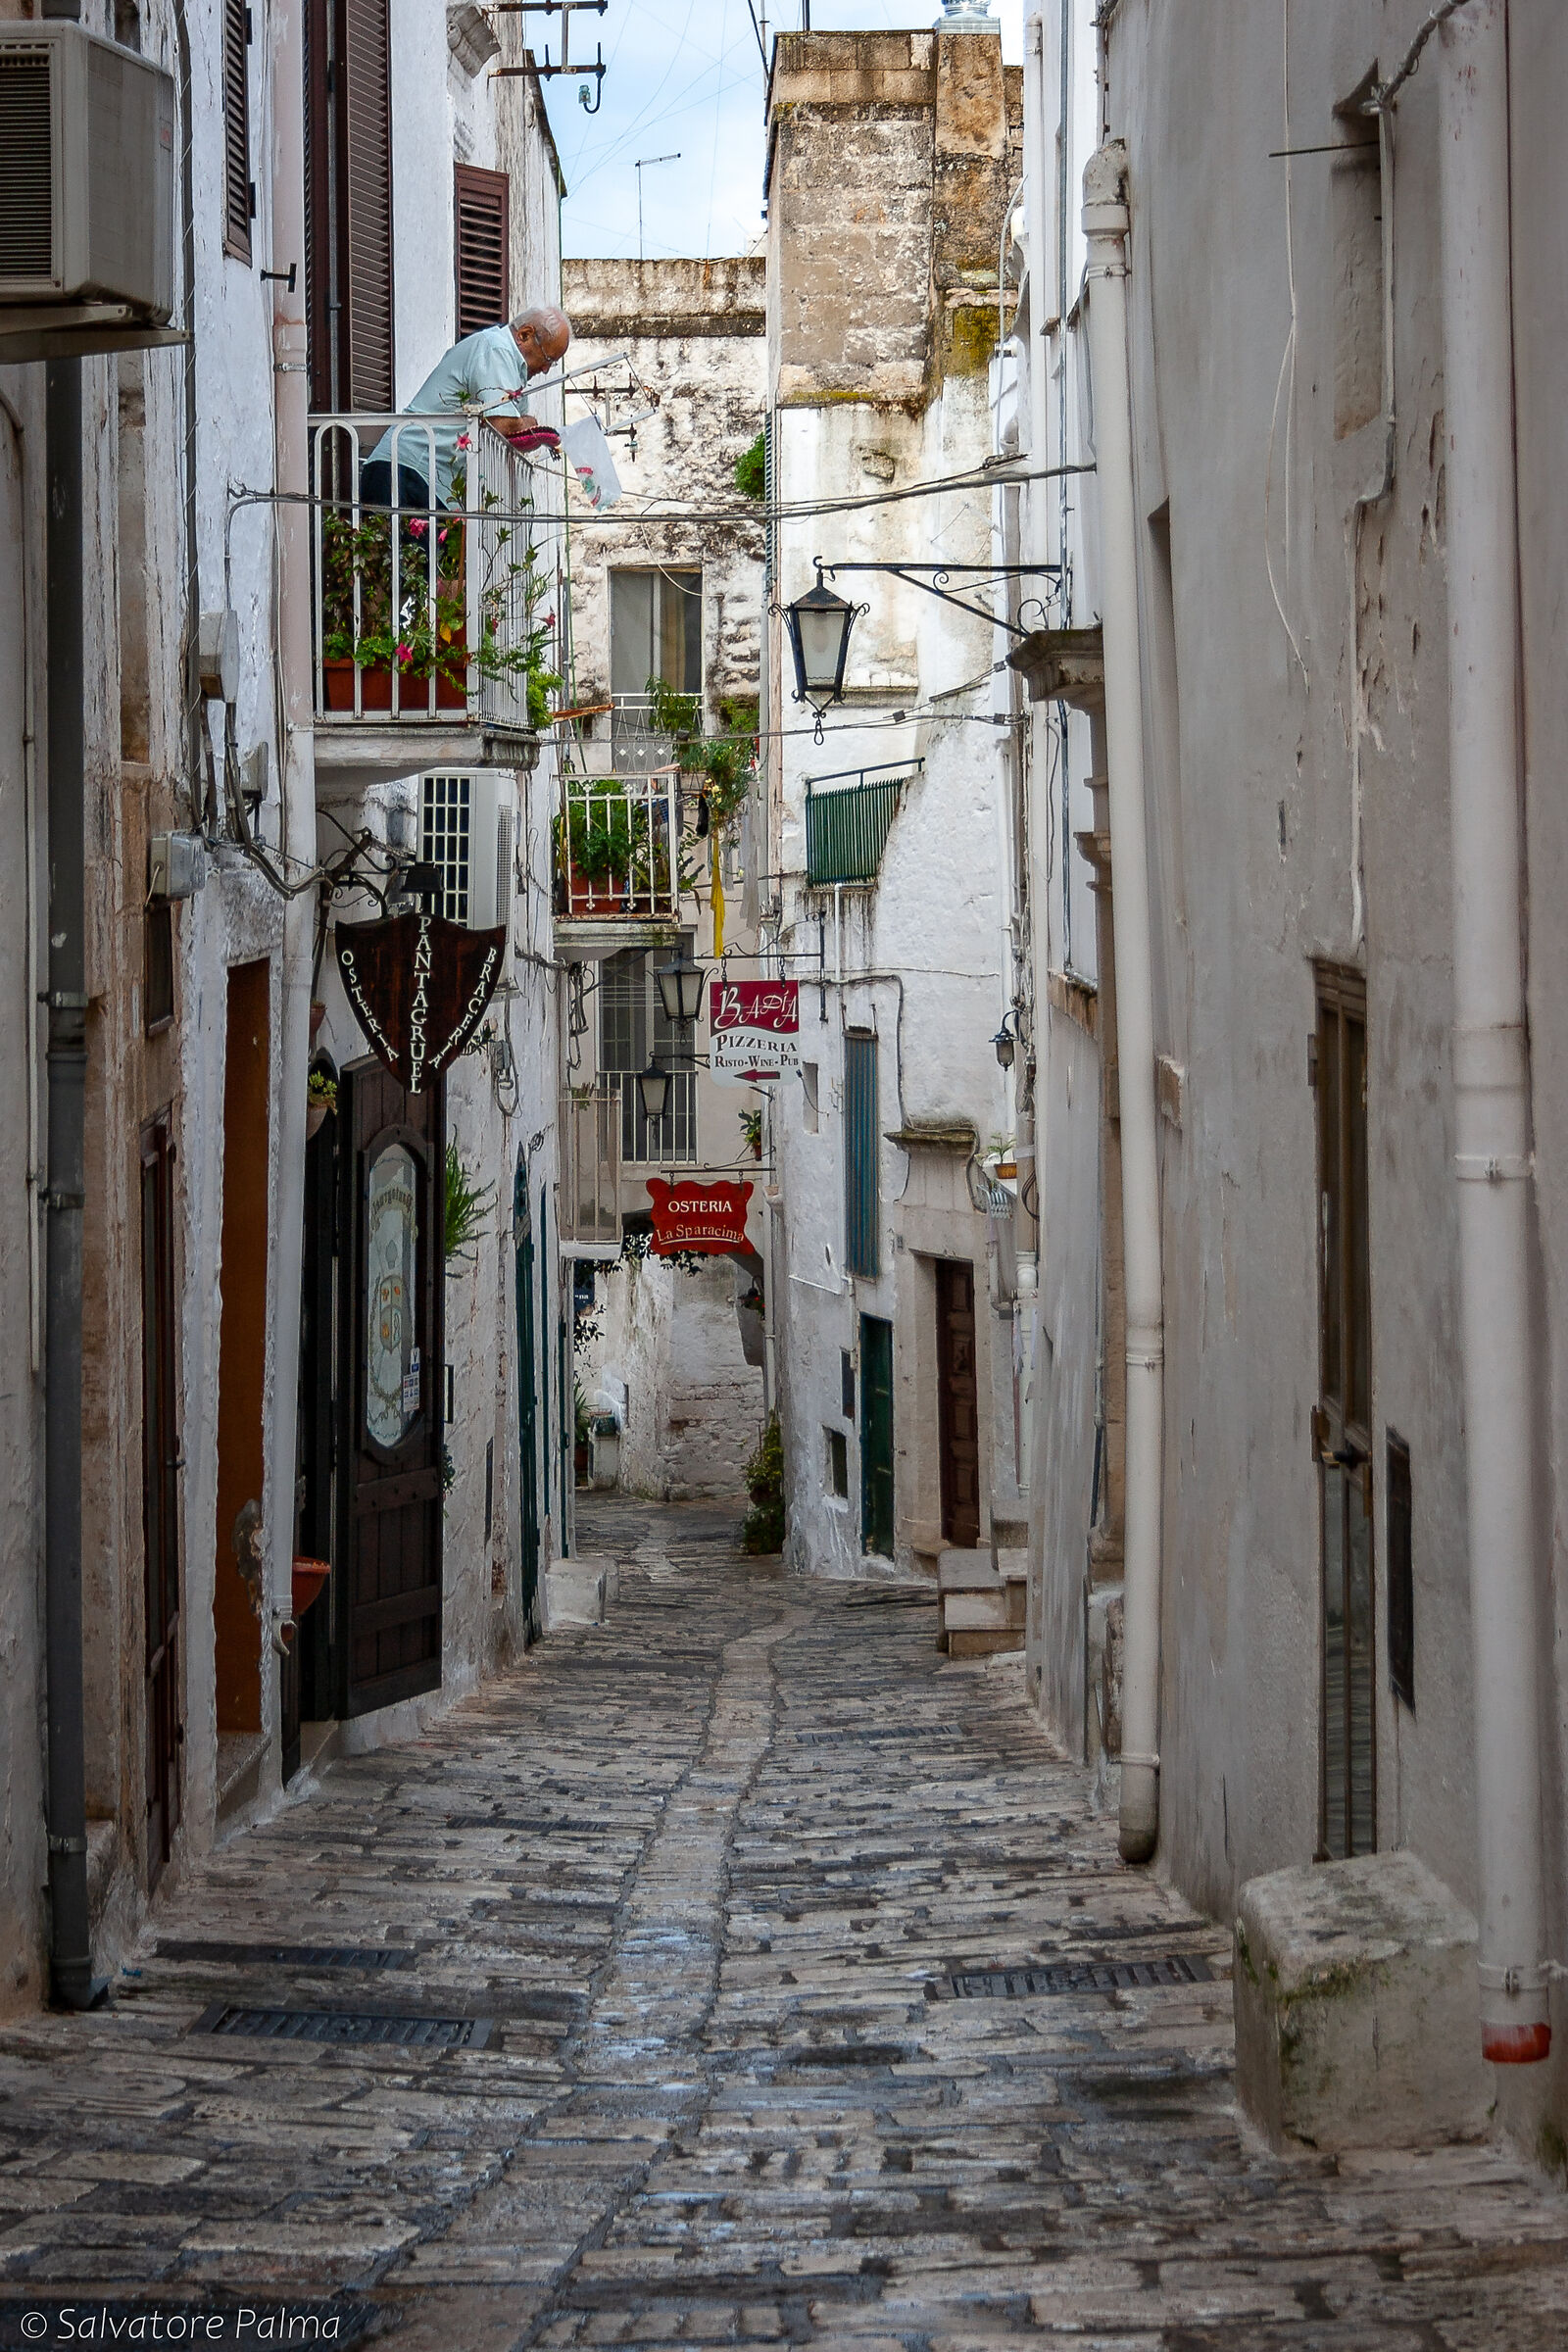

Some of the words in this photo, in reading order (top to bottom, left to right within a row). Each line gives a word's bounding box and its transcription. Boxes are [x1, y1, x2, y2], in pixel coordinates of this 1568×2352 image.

[341, 951, 399, 1061] OSTERIA
[410, 915, 431, 1094] PANTAGRUEL
[428, 947, 497, 1068] BRACERIA
[716, 1034, 798, 1053] PIZZERIA
[656, 1229, 673, 1242] La
[667, 1200, 733, 1213] OSTERIA
